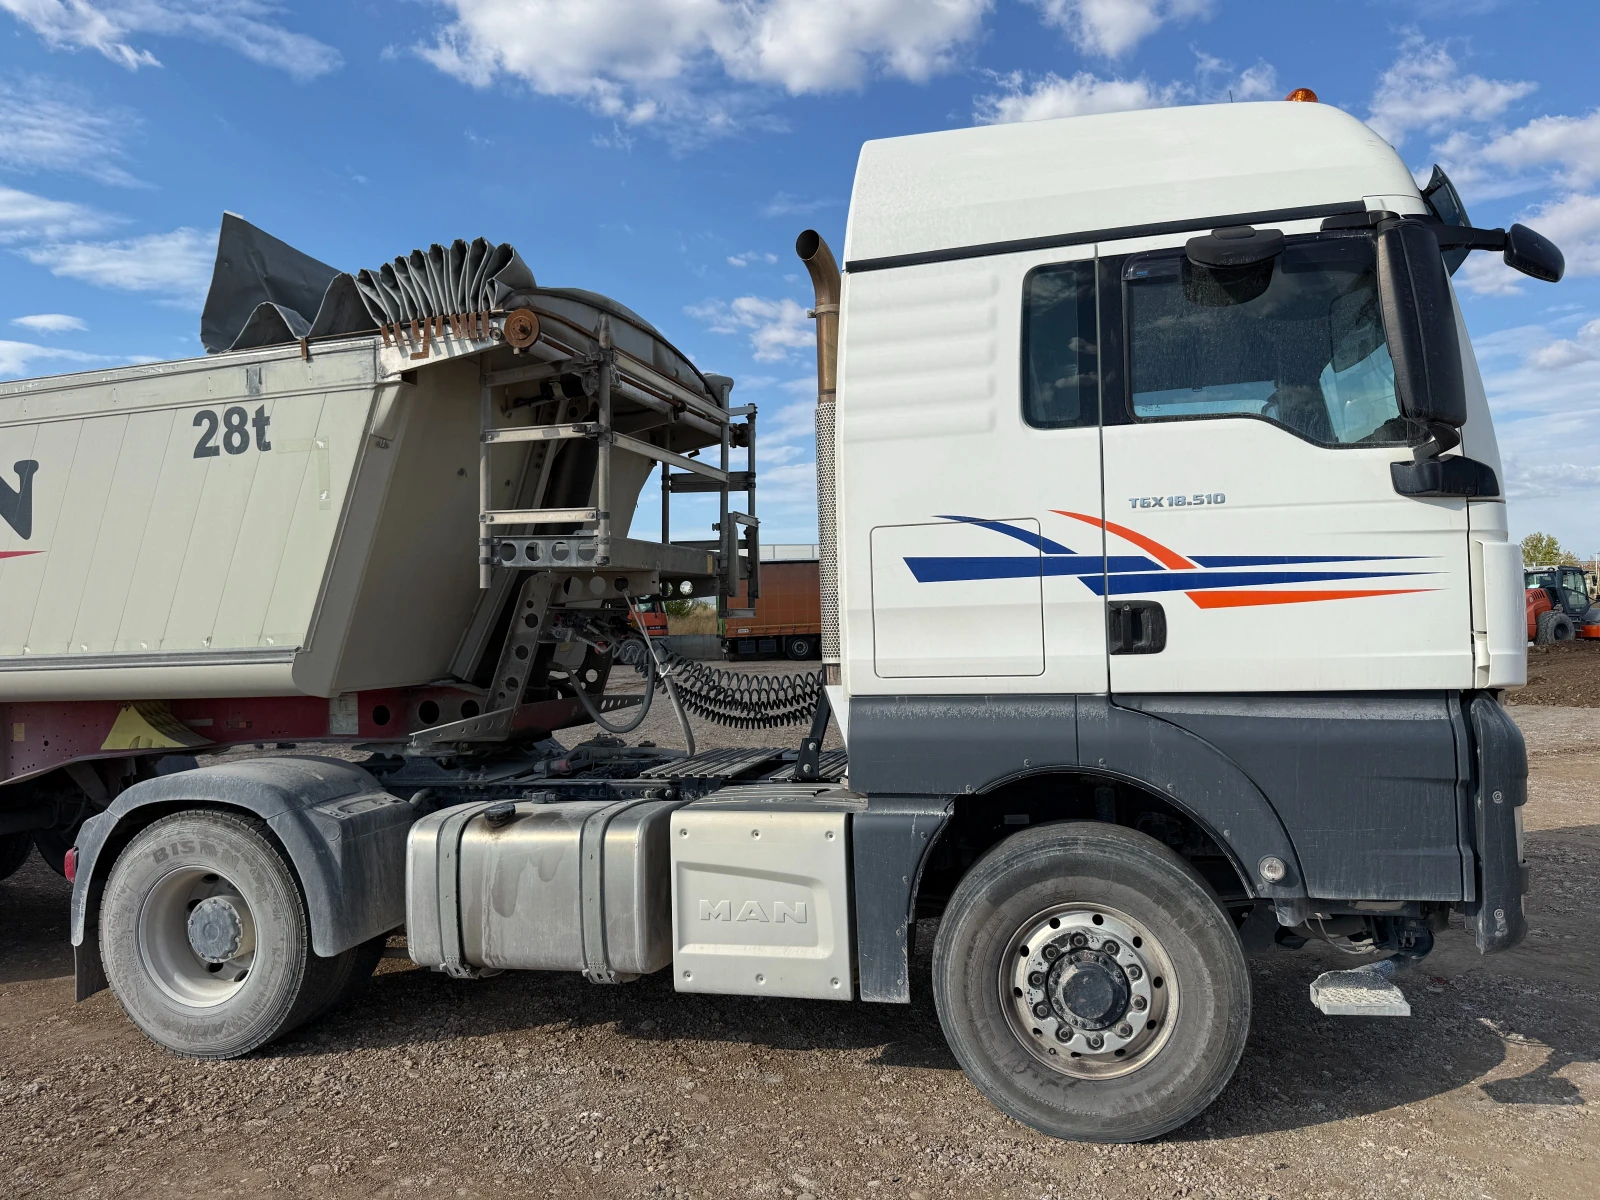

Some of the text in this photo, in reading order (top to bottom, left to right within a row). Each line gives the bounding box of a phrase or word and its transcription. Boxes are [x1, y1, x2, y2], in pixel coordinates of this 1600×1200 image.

[192, 403, 272, 459] 28t
[1128, 492, 1226, 509] TGX 18.510
[699, 899, 808, 924] MAN
